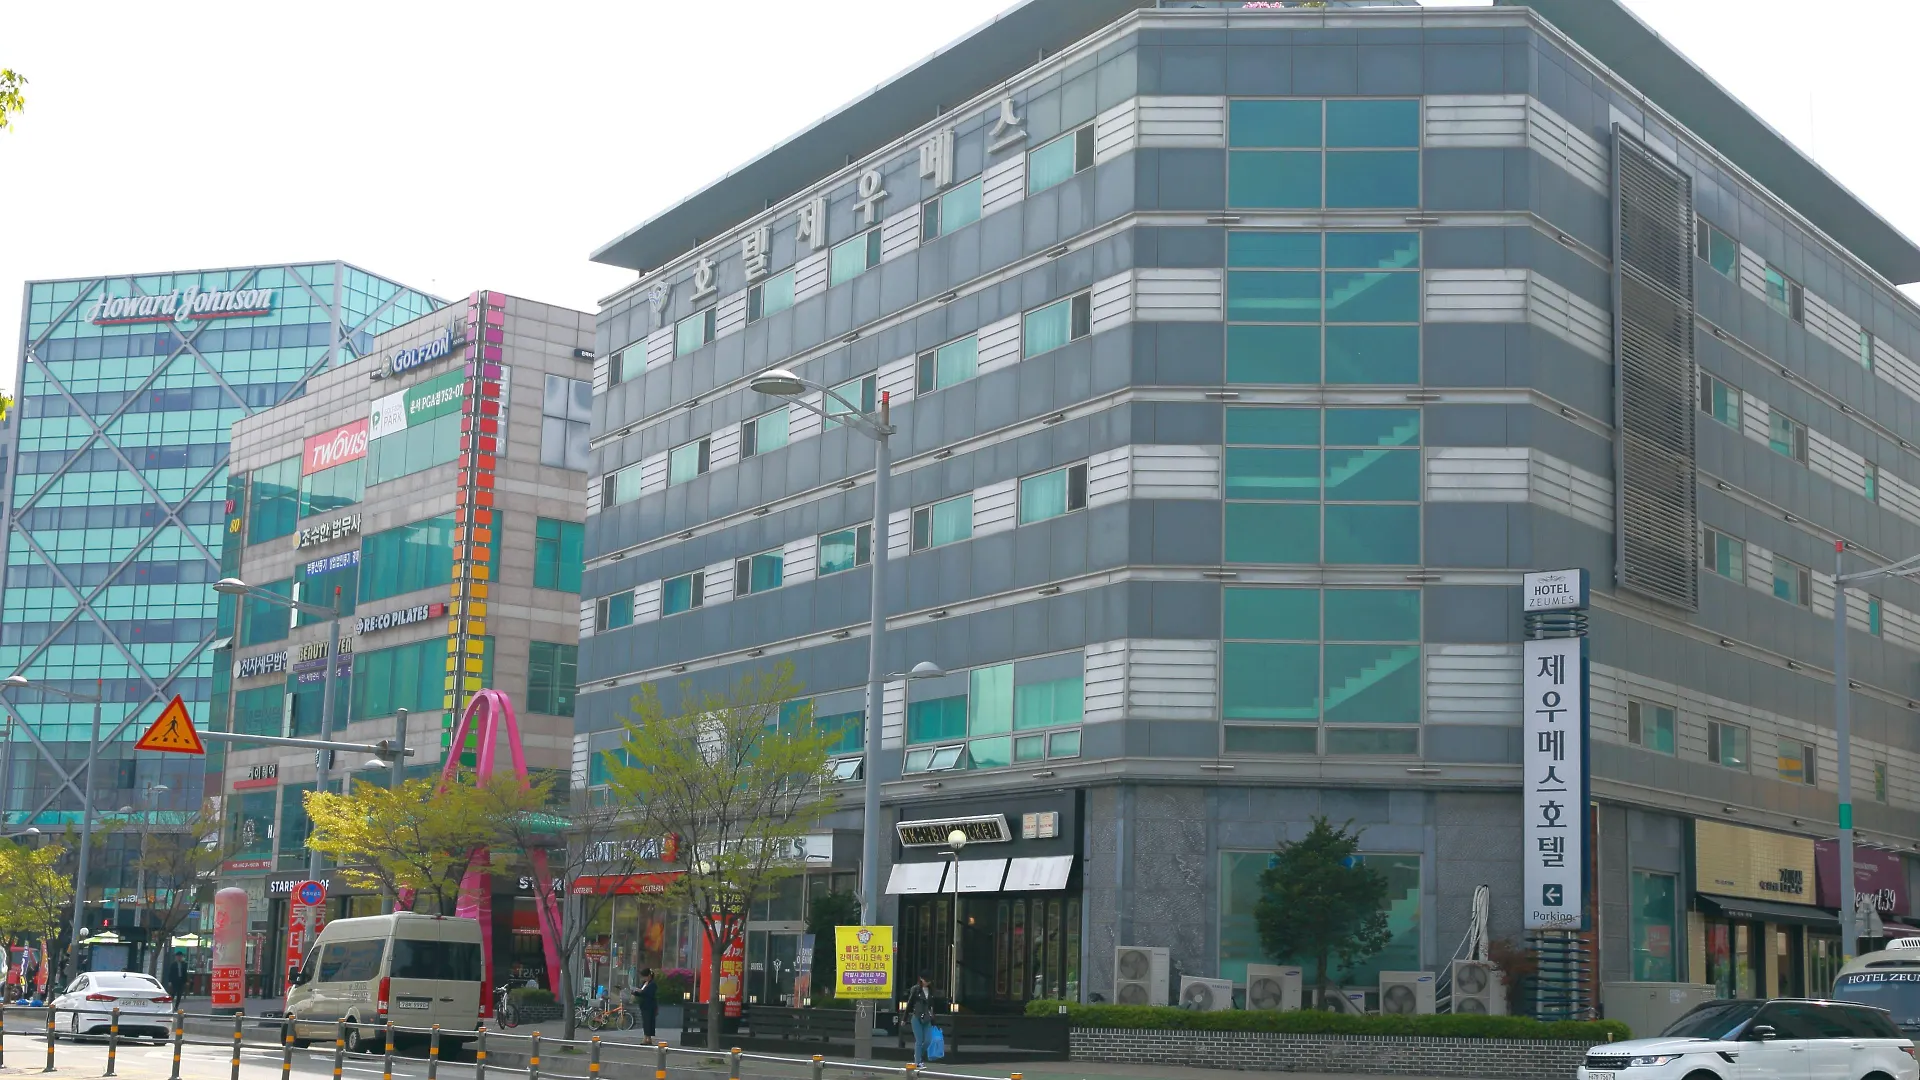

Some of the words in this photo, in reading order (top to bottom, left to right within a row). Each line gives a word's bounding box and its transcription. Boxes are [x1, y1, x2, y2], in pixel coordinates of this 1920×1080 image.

[84, 289, 180, 323] Howard
[175, 284, 274, 322] Johnson
[393, 331, 451, 373] GOLFZON
[383, 413, 402, 427] PARK
[332, 513, 361, 539] 법무사
[1534, 583, 1570, 596] HOTEL
[1529, 595, 1575, 607] ZEUMES
[364, 613, 391, 633] RE:CO
[391, 604, 429, 627] PILATES
[1535, 654, 1568, 868] 제우메스호텔
[1533, 911, 1573, 925] Parking
[1848, 973, 1887, 985] HOTEL
